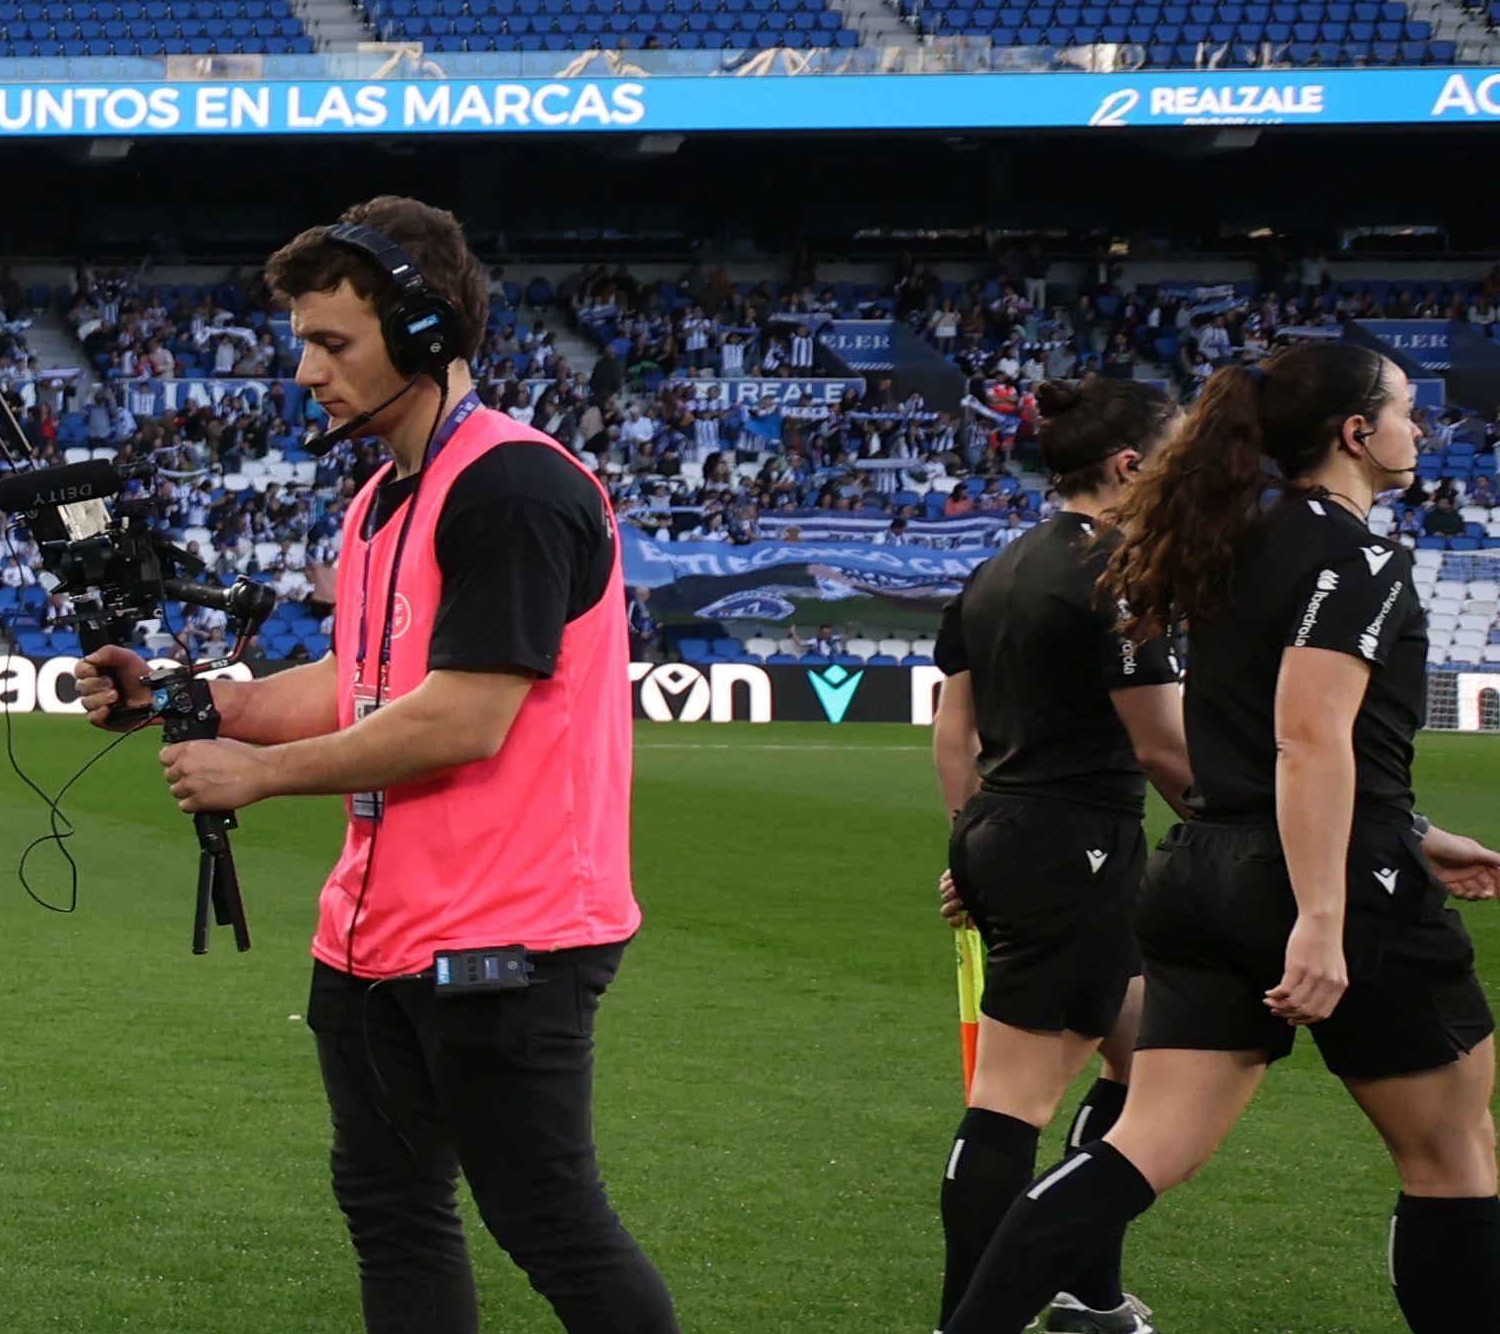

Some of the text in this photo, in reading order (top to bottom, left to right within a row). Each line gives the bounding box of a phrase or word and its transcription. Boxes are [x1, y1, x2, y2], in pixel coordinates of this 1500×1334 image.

[195, 85, 269, 127] EN
[298, 83, 387, 127] LAS
[403, 82, 646, 126] MARCAS
[1148, 85, 1324, 117] REALZALE
[1430, 74, 1500, 116] AC
[820, 334, 891, 349] ELER
[738, 381, 847, 404] REALE
[33, 483, 93, 506] DEITY
[1296, 589, 1331, 647] Iberdrola
[1365, 579, 1403, 637] Iberdrola
